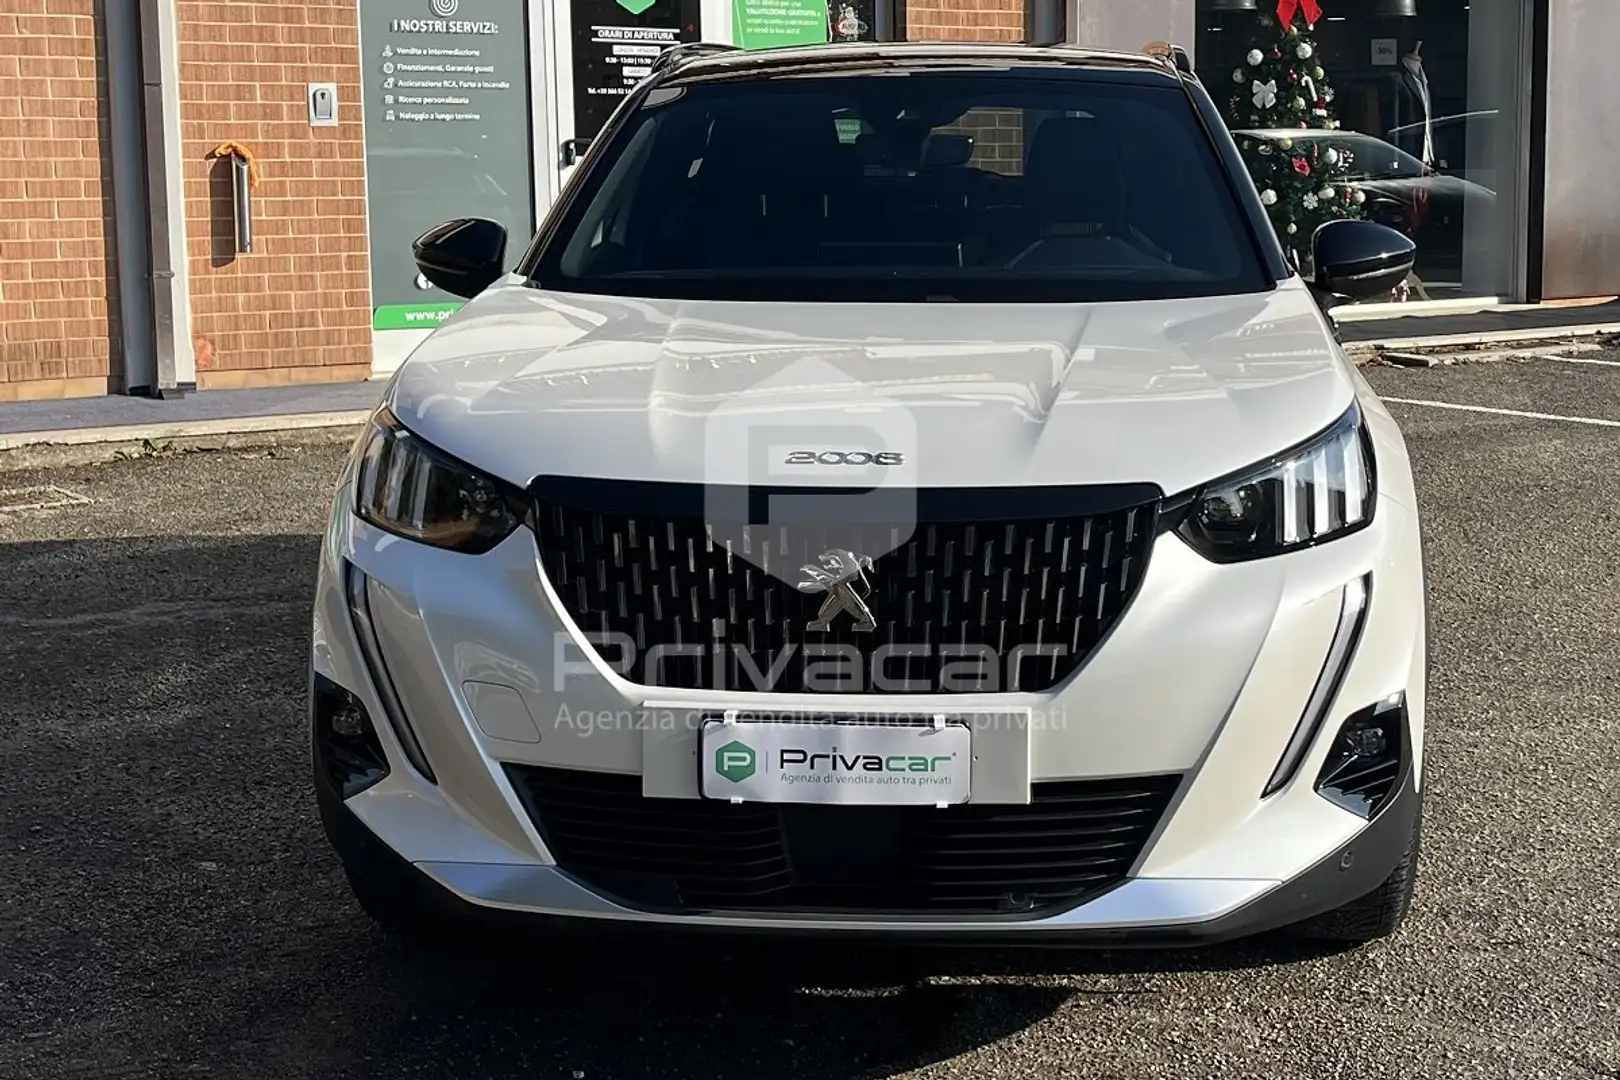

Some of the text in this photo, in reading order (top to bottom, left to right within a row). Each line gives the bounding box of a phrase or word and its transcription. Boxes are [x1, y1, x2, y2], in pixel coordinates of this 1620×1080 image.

[394, 19, 498, 34] I NOSTRI SERVIZI:
[598, 30, 674, 40] ORARI DI APERTURA
[400, 112, 429, 121] Noleggio
[436, 112, 454, 120] lungo
[785, 450, 904, 466] 2008
[781, 772, 820, 784] Agenzia
[824, 773, 833, 782] di
[836, 774, 874, 784] vendita
[877, 776, 900, 784] auto
[919, 776, 952, 786] privati
